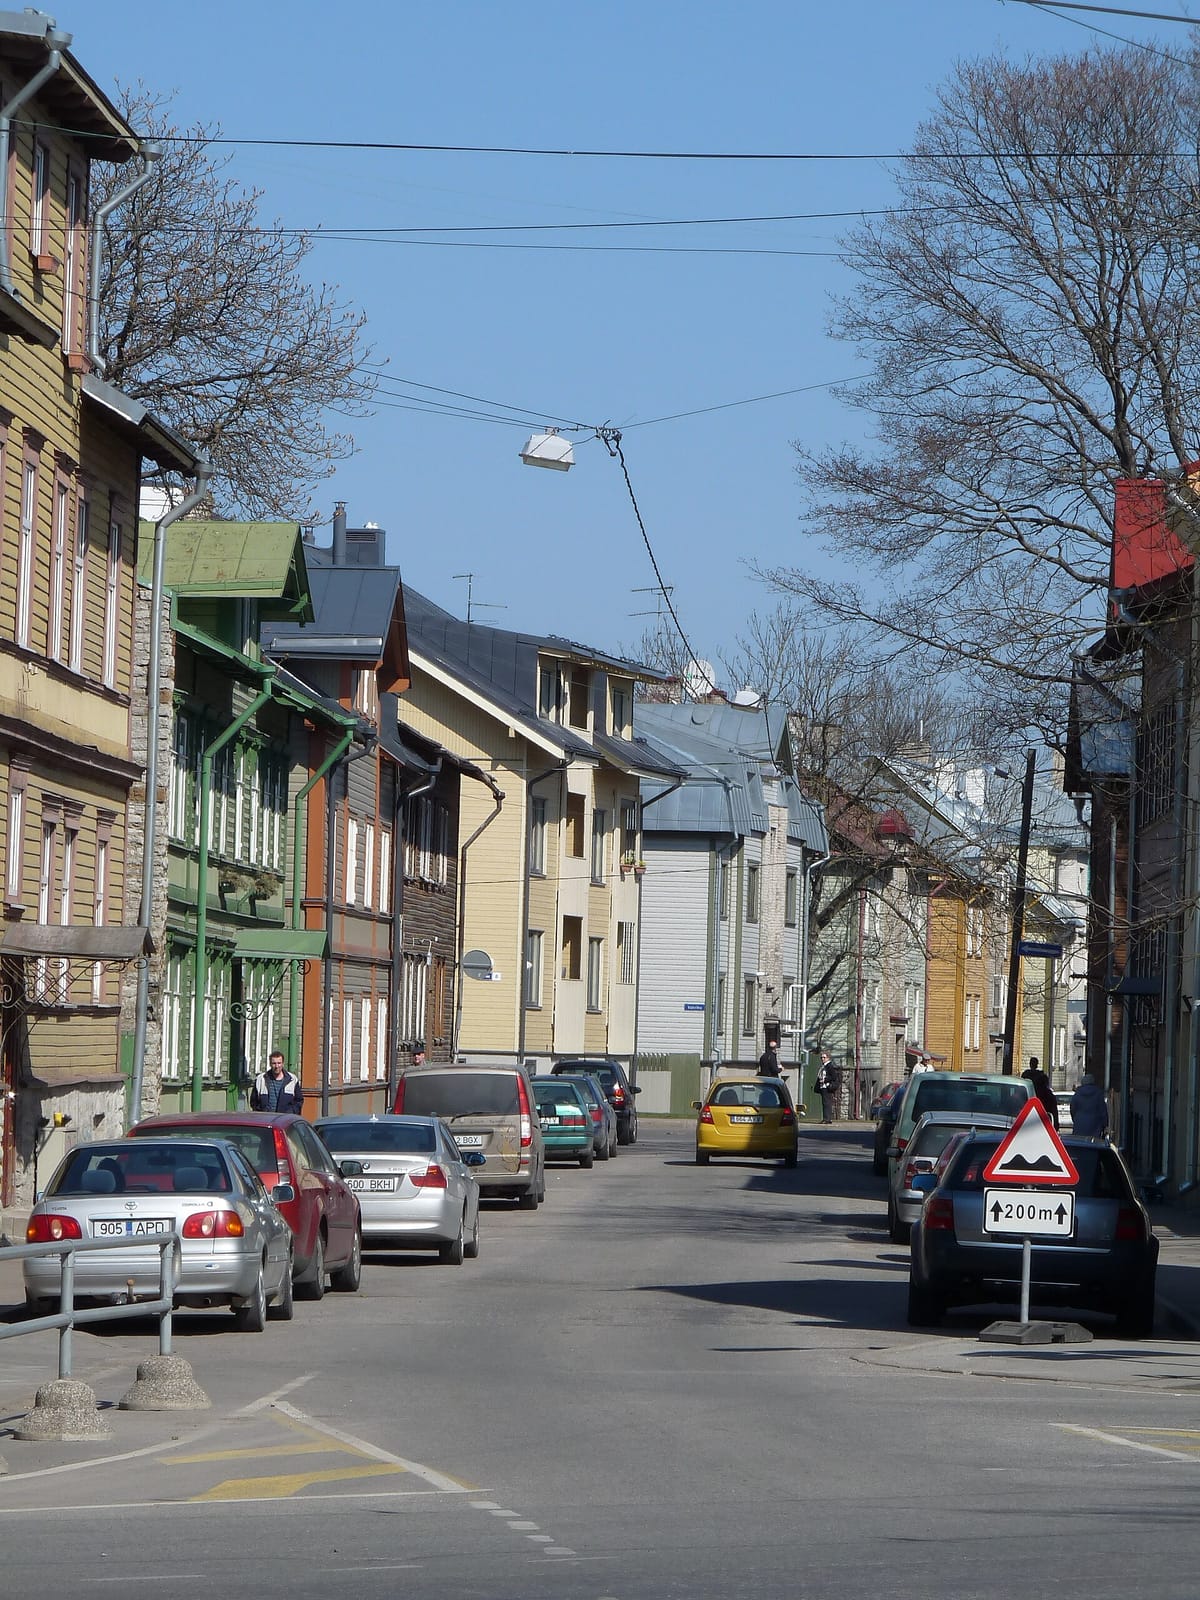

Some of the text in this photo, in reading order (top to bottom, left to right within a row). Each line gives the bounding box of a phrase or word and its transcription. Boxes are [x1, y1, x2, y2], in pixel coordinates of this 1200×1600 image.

[370, 1179, 391, 1189] BKH
[1004, 1203, 1053, 1221] 200m
[100, 1221, 164, 1235] 905 APD
